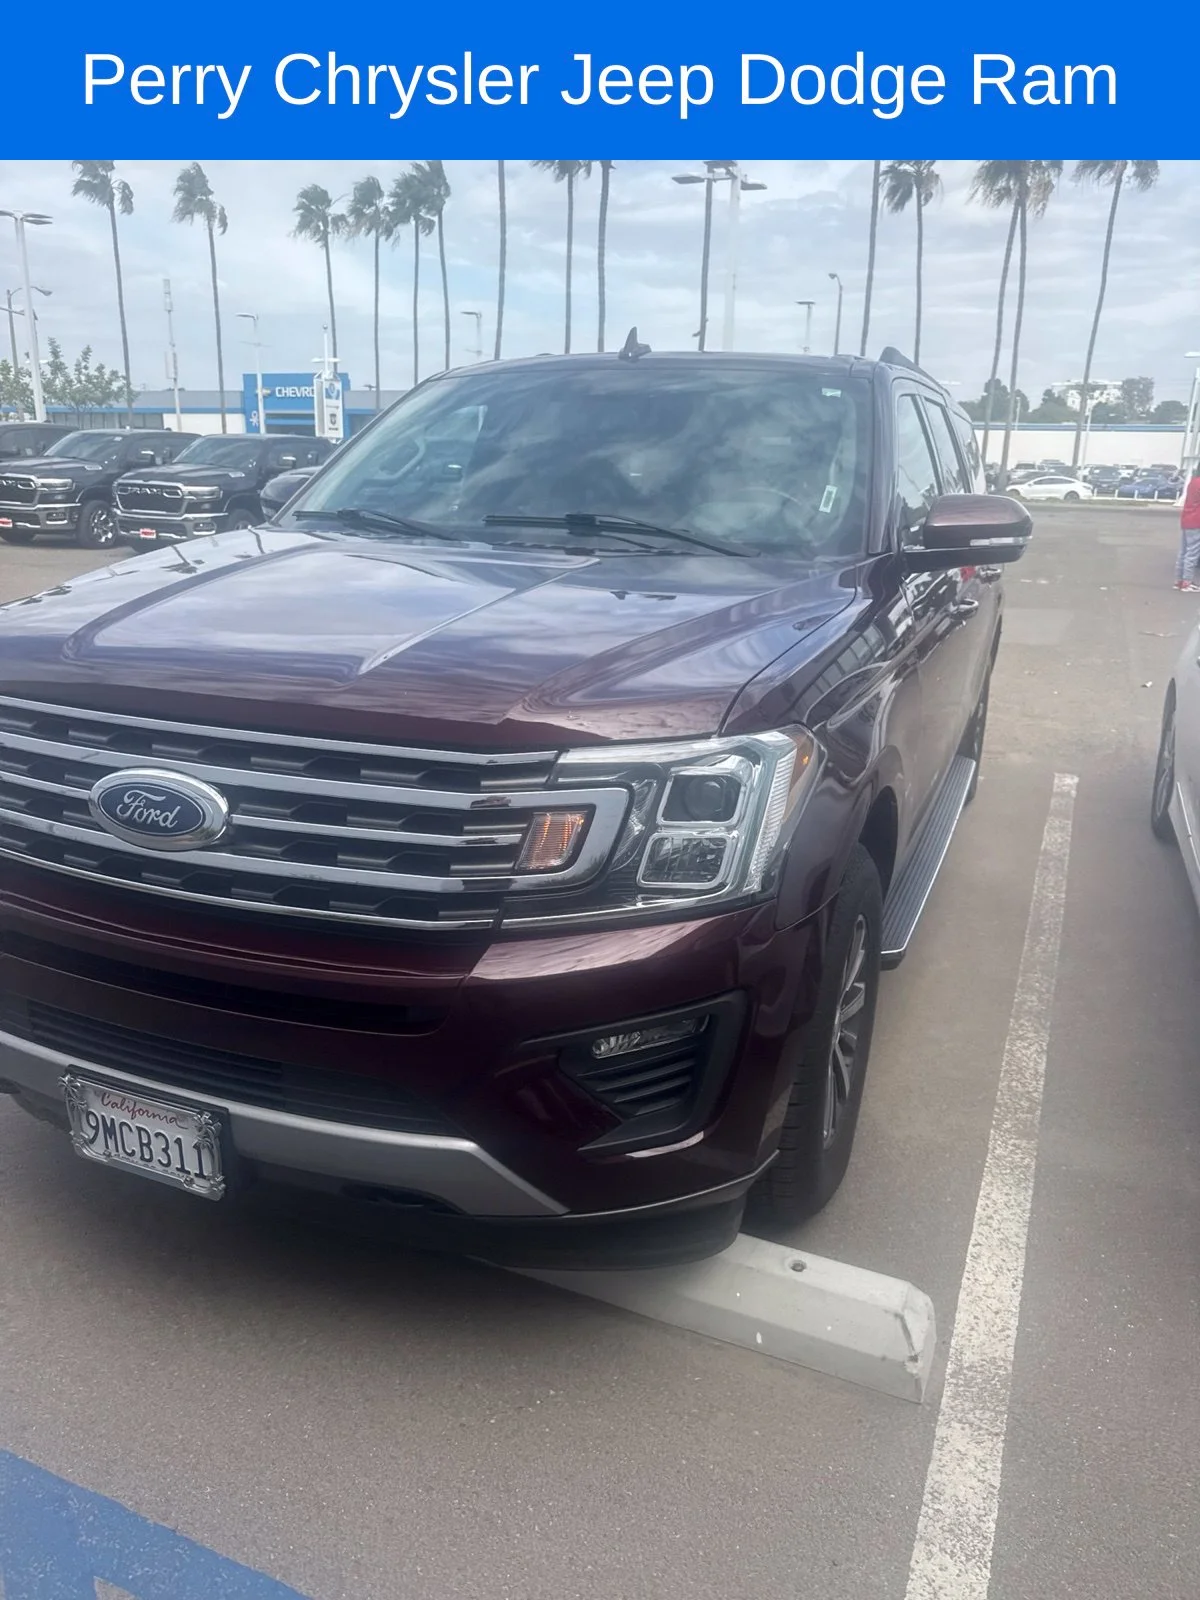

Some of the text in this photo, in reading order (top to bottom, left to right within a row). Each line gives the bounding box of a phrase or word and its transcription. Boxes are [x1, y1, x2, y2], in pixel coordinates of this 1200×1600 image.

[116, 789, 179, 829] Ford
[101, 1092, 188, 1130] California
[85, 1110, 207, 1181] 9MCB311
